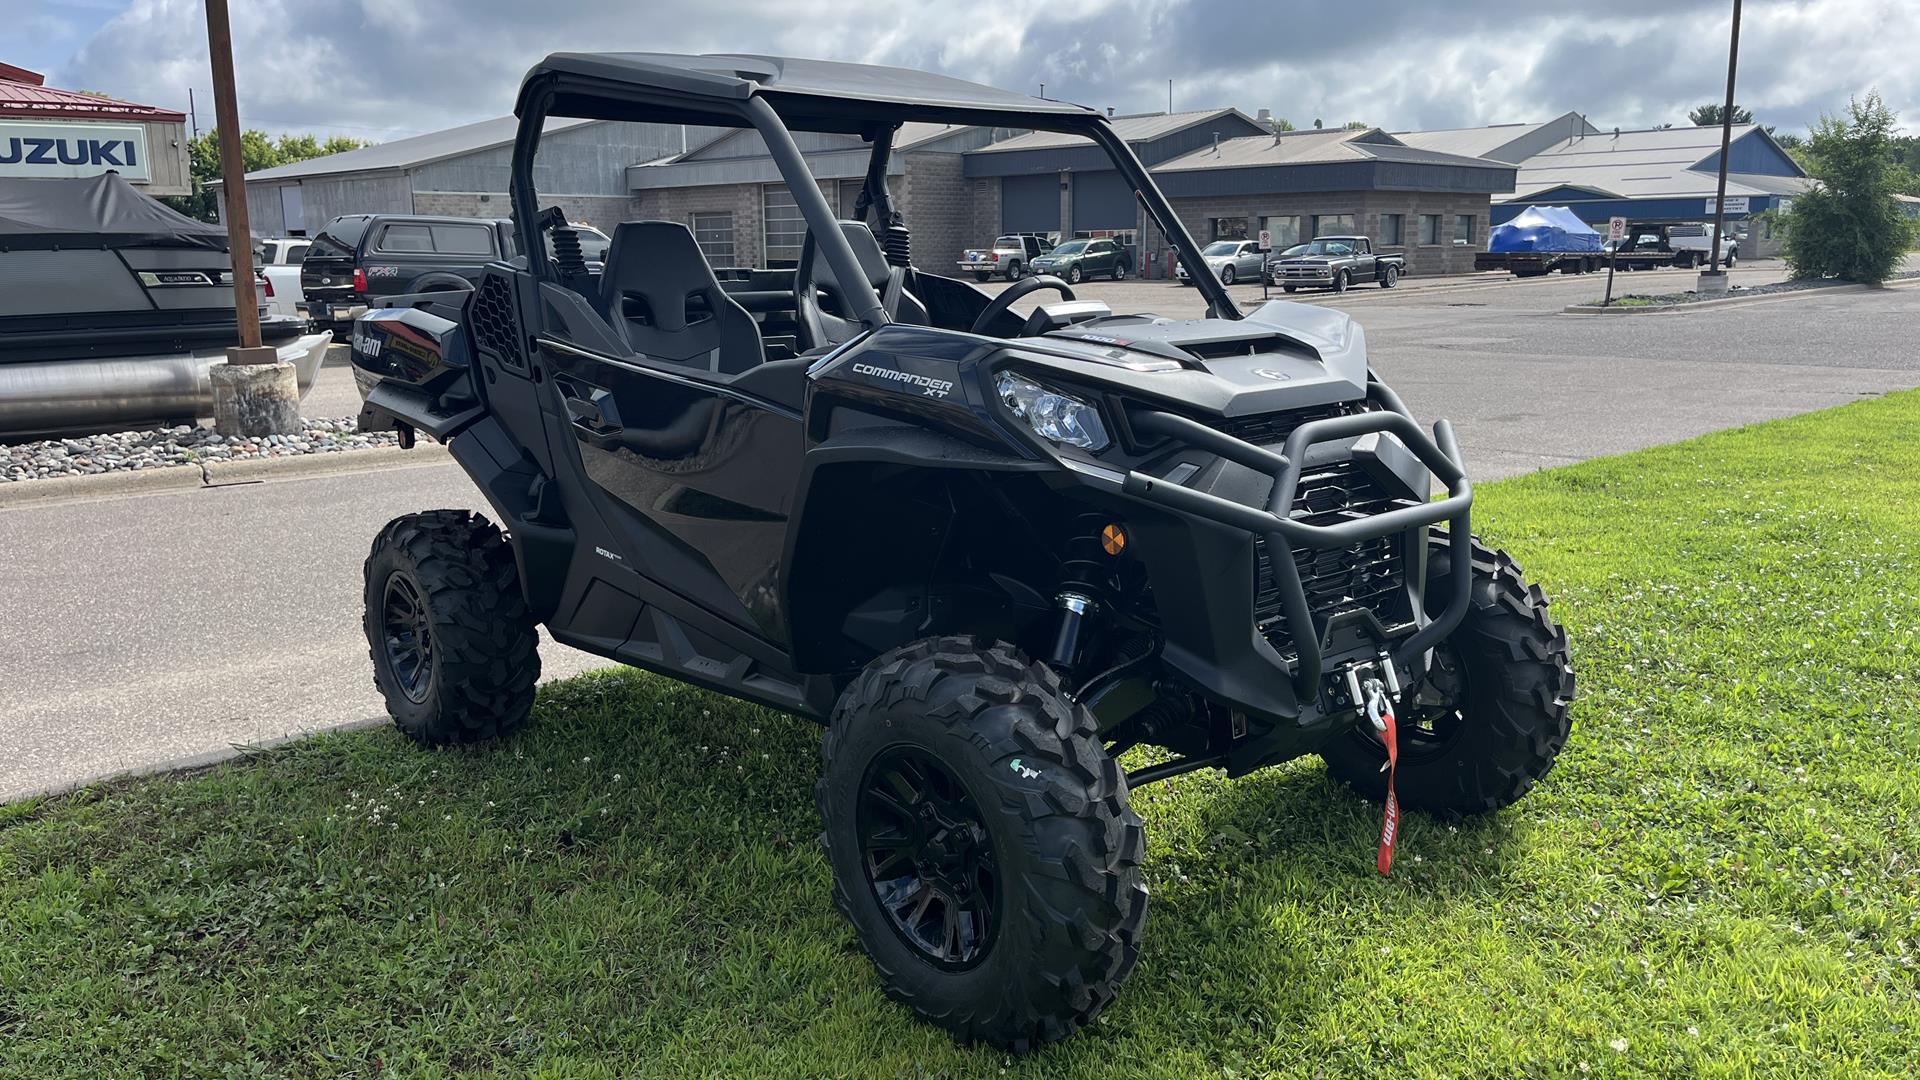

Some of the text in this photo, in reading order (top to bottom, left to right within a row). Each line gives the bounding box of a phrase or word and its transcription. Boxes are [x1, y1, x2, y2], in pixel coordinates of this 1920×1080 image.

[852, 363, 953, 391] COMMANDER
[923, 387, 949, 398] XT
[595, 546, 614, 560] ROTAX
